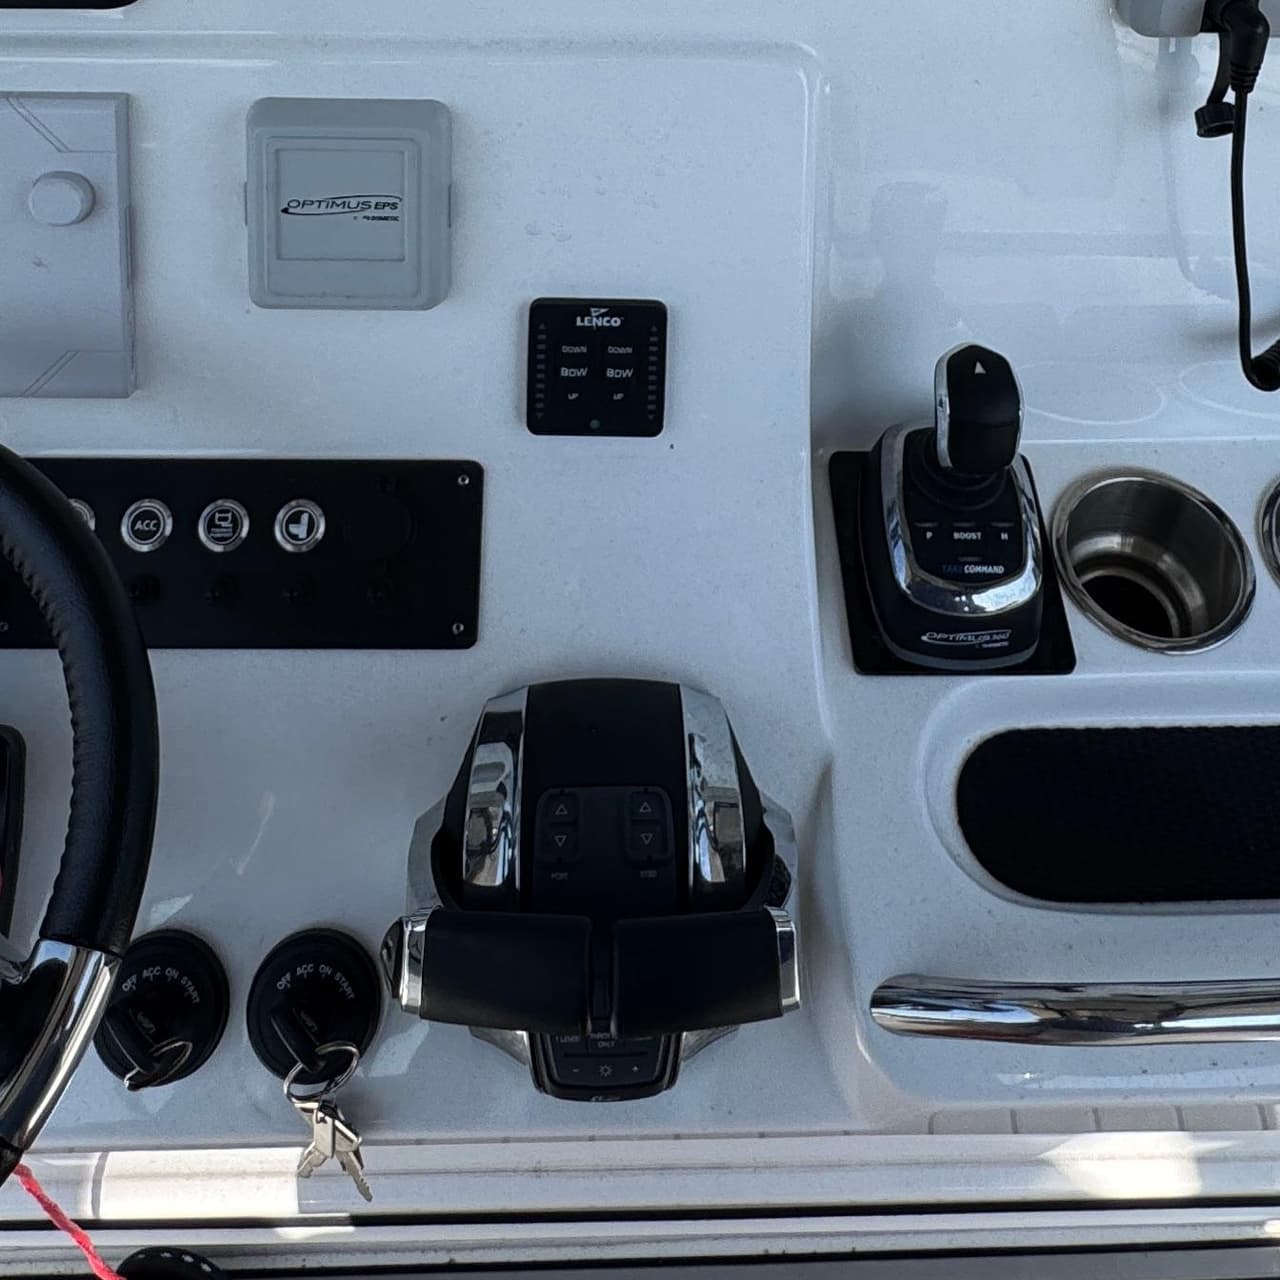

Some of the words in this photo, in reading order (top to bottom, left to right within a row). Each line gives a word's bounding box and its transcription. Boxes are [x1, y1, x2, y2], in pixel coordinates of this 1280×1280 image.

[287, 198, 372, 210] OPTIMUS
[373, 201, 399, 211] EPS
[575, 316, 622, 328] LENCO
[561, 345, 588, 353] DOWN
[607, 345, 633, 354] DOWN
[560, 367, 588, 377] BOW
[606, 368, 634, 378] BOW
[133, 519, 159, 531] ACC
[953, 531, 982, 540] BOOST
[963, 564, 1005, 574] COMMAND
[142, 966, 161, 978] ACC
[165, 967, 179, 979] ON
[296, 963, 315, 976] ACC
[318, 964, 333, 976] ON
[181, 976, 200, 1004] START
[334, 971, 356, 1000] START
